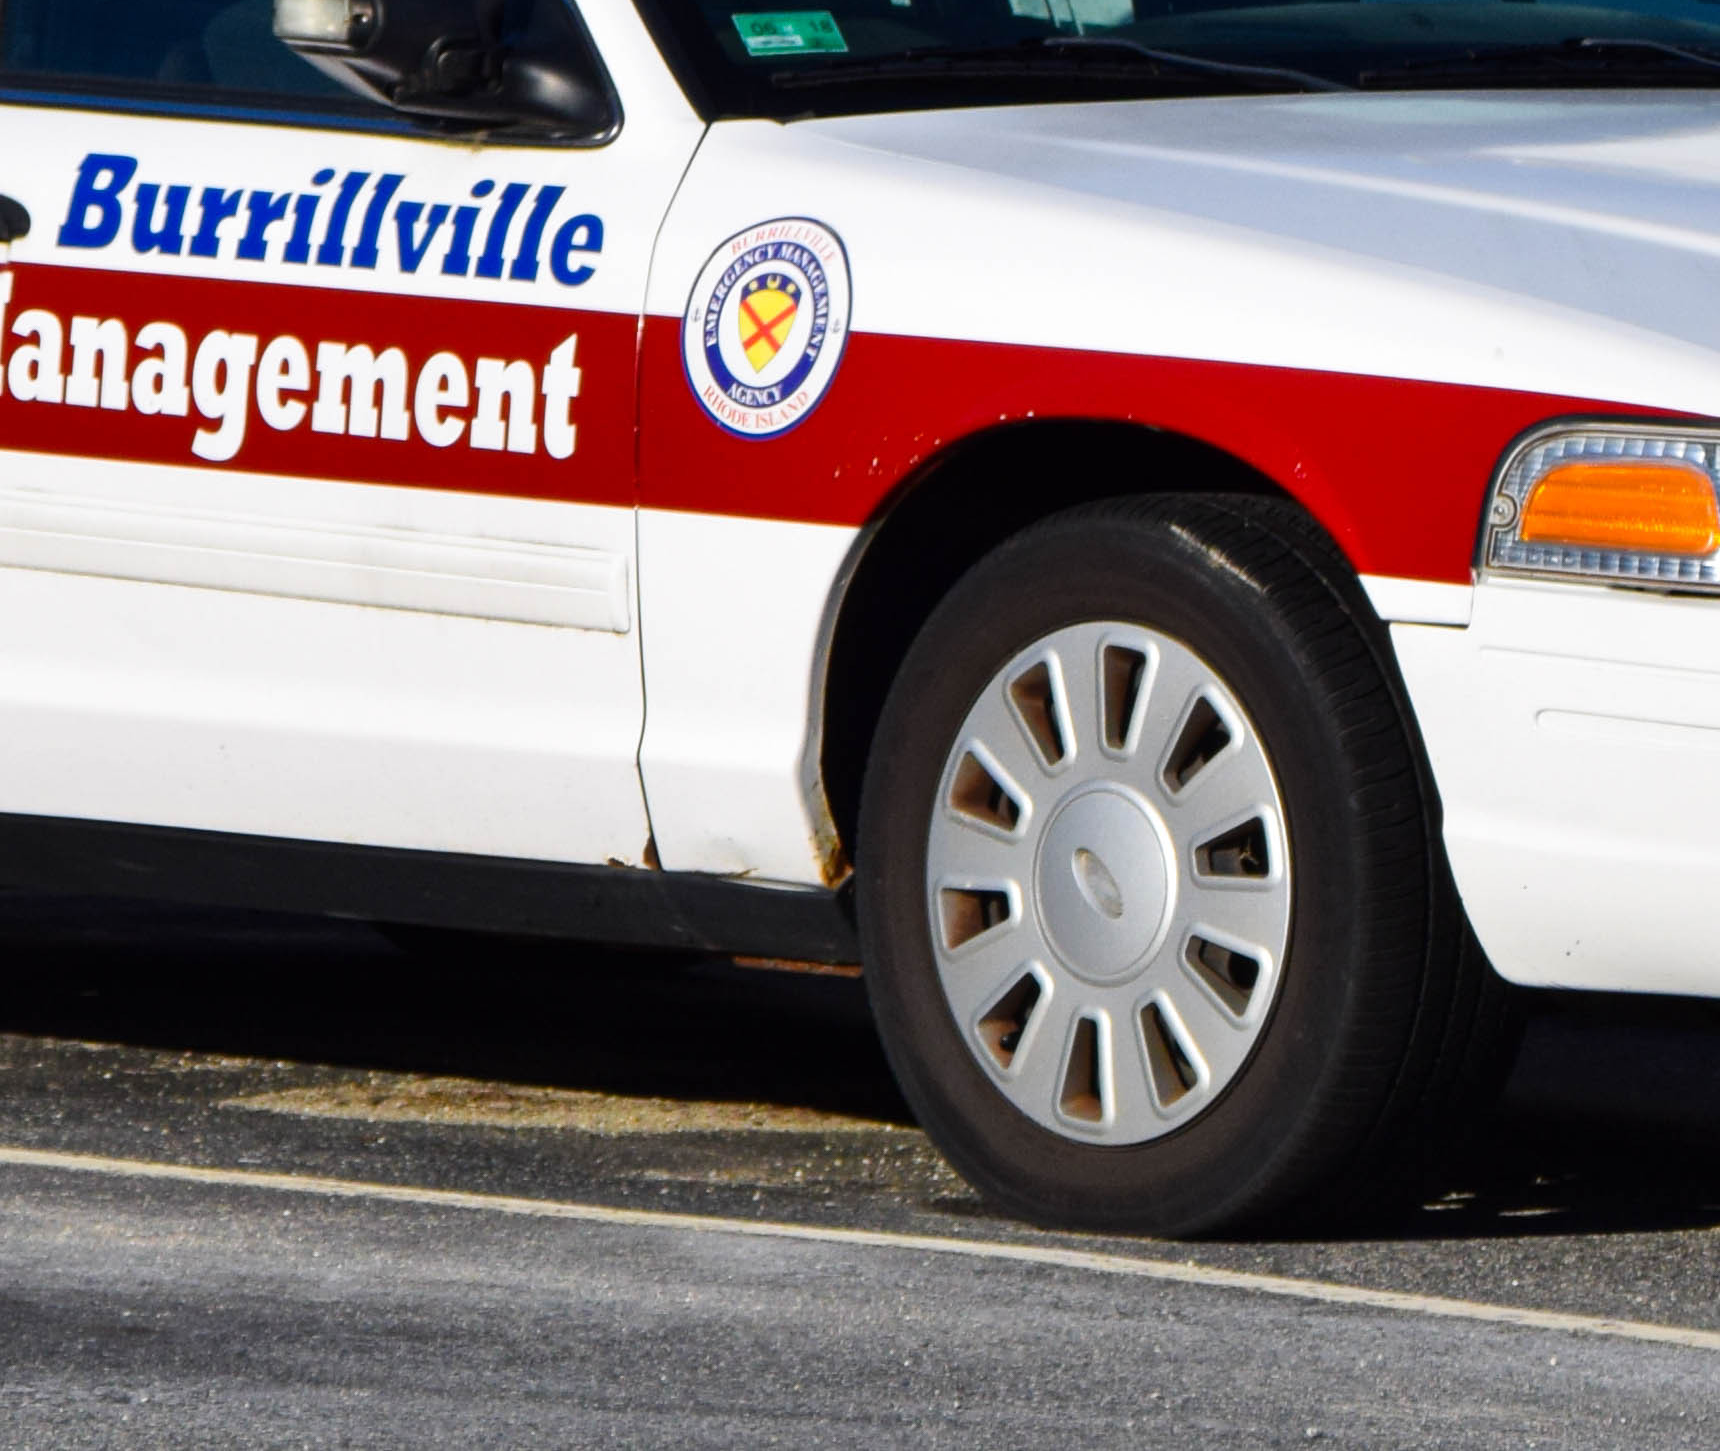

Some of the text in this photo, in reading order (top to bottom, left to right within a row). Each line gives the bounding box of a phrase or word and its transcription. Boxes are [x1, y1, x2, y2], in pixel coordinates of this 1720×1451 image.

[58, 153, 606, 288] Burrillville
[705, 243, 830, 362] EMERGENCY MANAGEMENT
[703, 385, 810, 430] RHODE ISLAND
[727, 381, 783, 407] AGENCY
